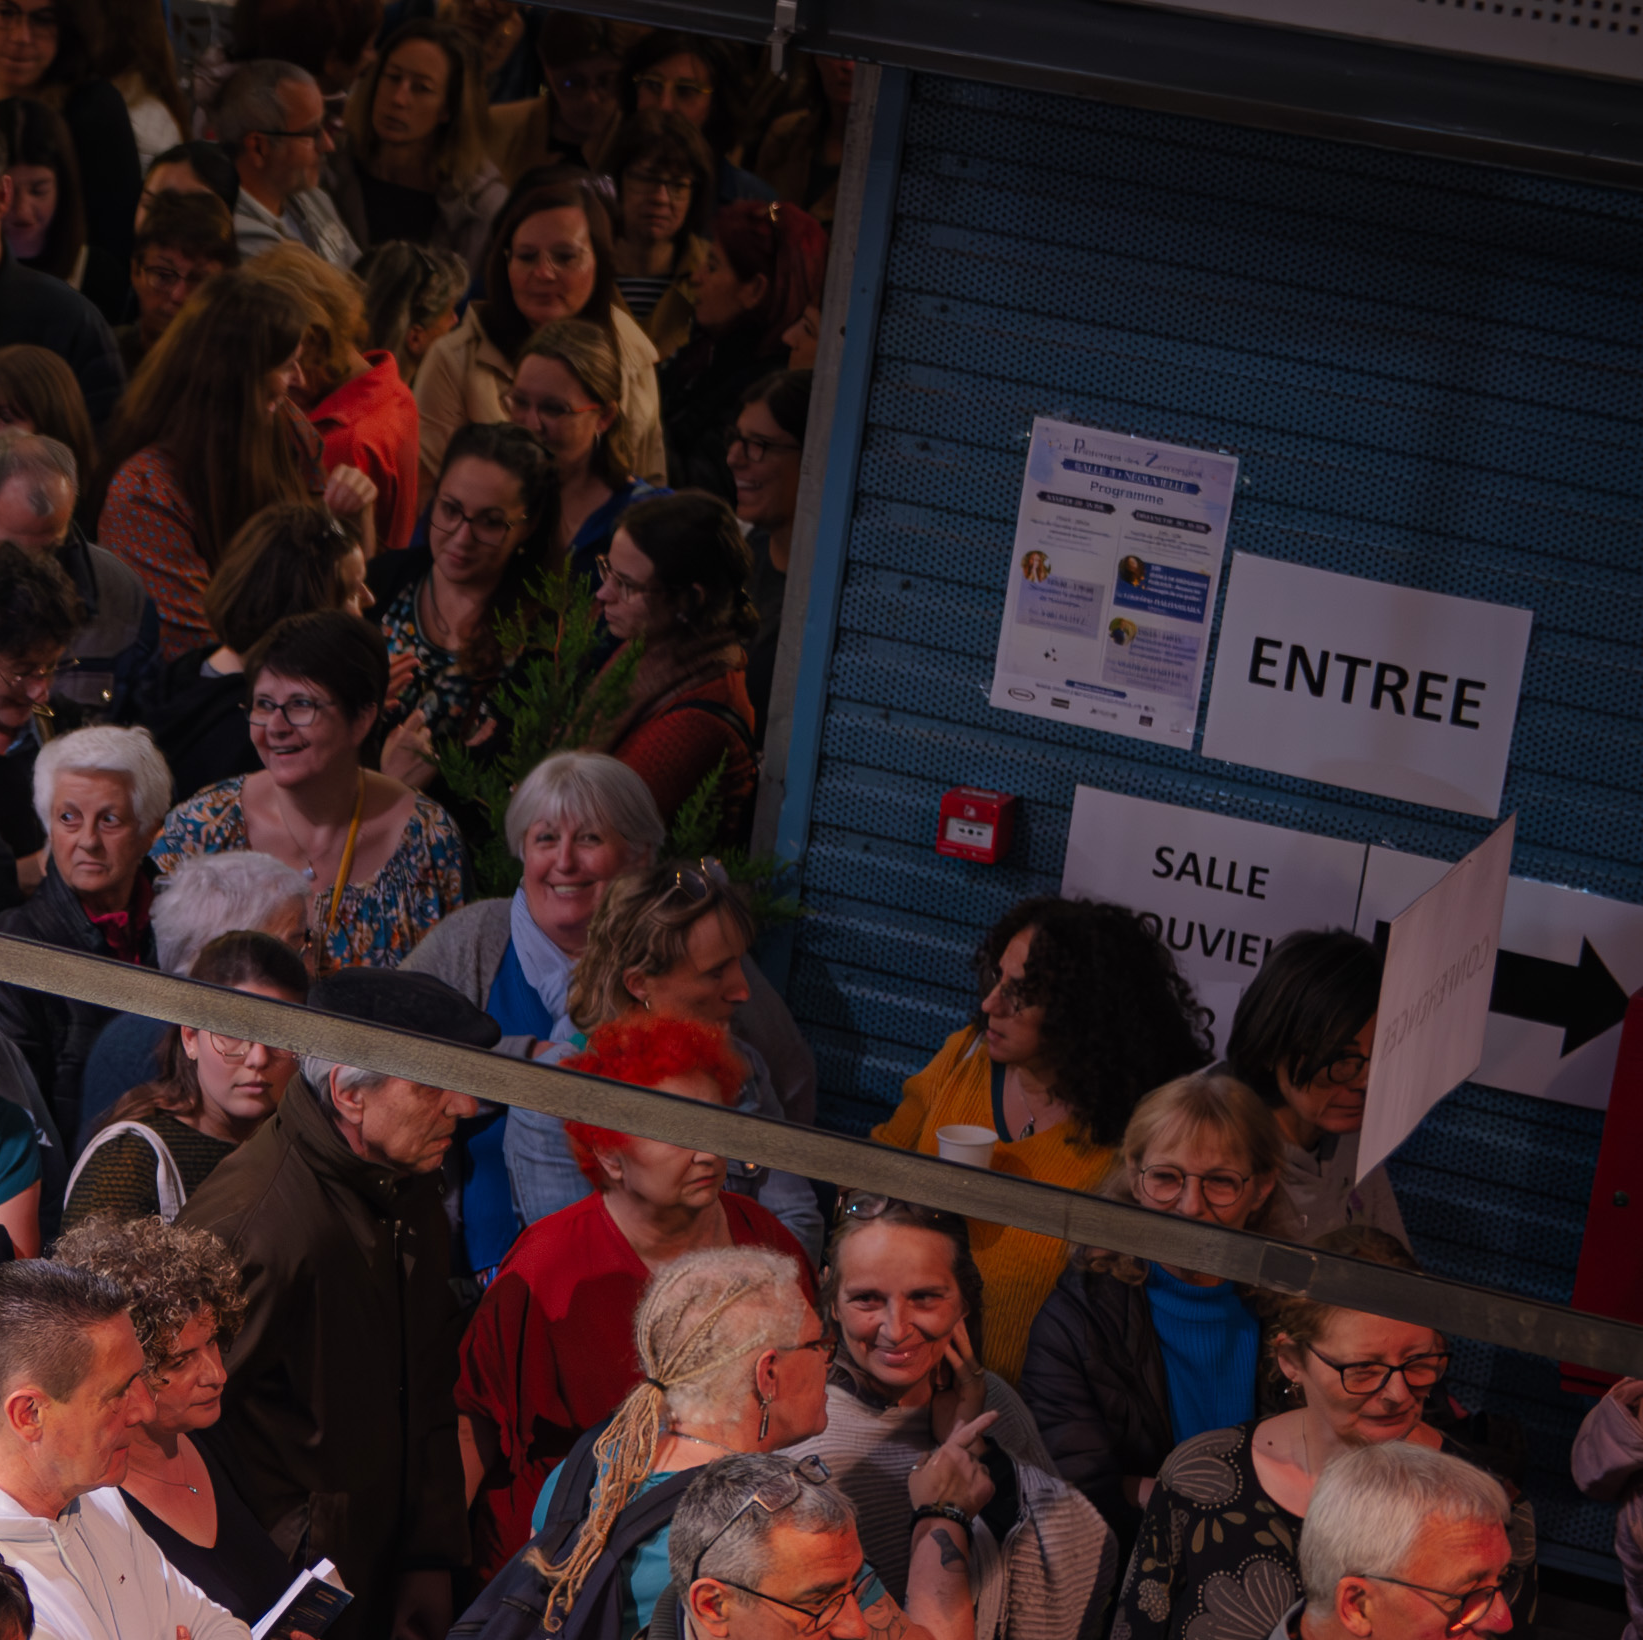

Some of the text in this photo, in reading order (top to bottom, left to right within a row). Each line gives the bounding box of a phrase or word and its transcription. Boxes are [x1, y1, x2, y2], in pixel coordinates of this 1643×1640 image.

[1090, 480, 1164, 506] Programme
[1247, 635, 1487, 731] ENTREE
[1151, 846, 1270, 900] SALLE
